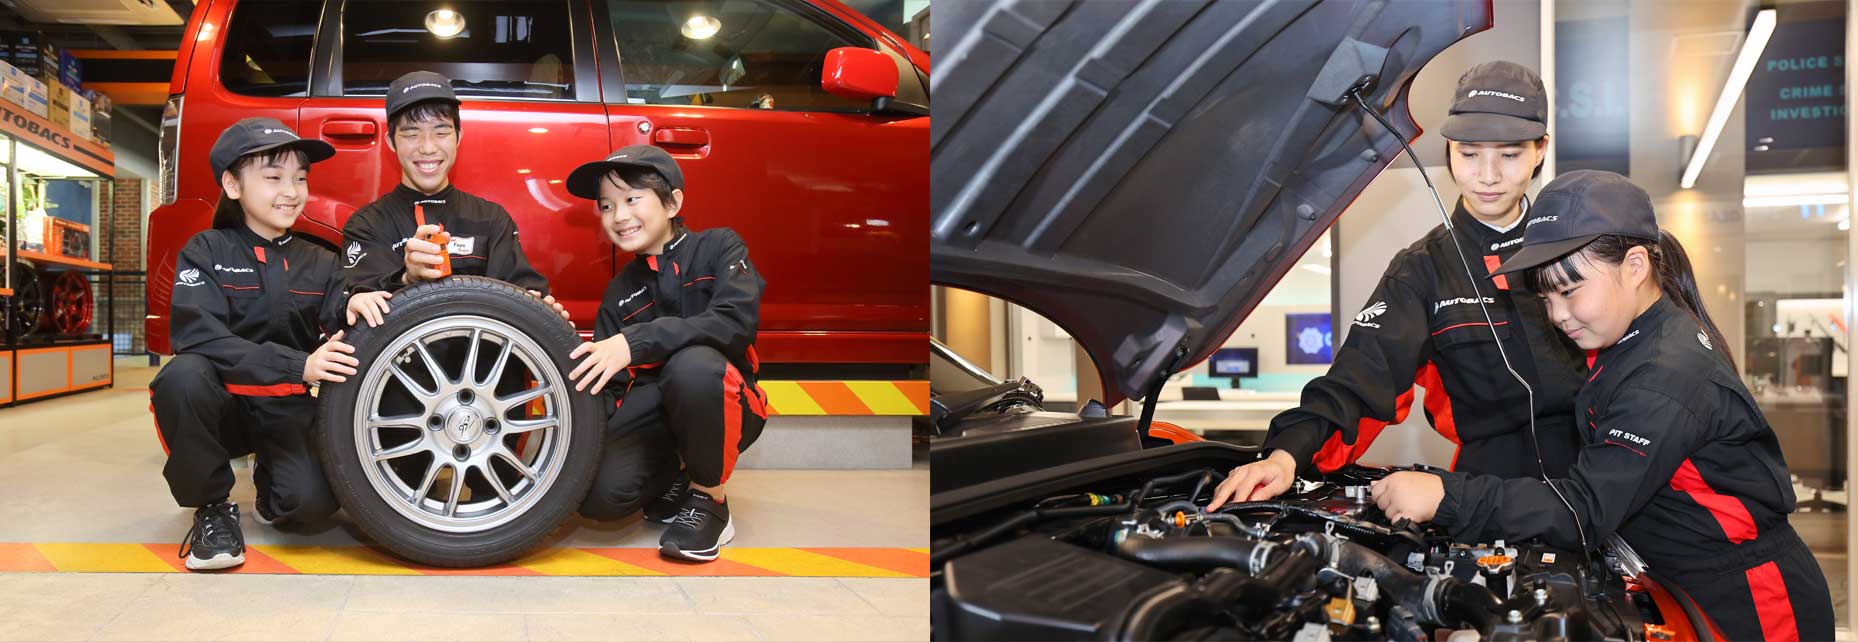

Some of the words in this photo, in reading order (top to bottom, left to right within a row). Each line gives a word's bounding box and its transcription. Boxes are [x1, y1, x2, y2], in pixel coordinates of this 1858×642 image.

[1767, 56, 1828, 71] POLICE
[1477, 90, 1525, 102] AUTOBACS
[1780, 84, 1832, 99] CRIME
[0, 106, 71, 149] TOBACS
[1609, 428, 1623, 438] PIT
[1623, 432, 1651, 446] STAFF
